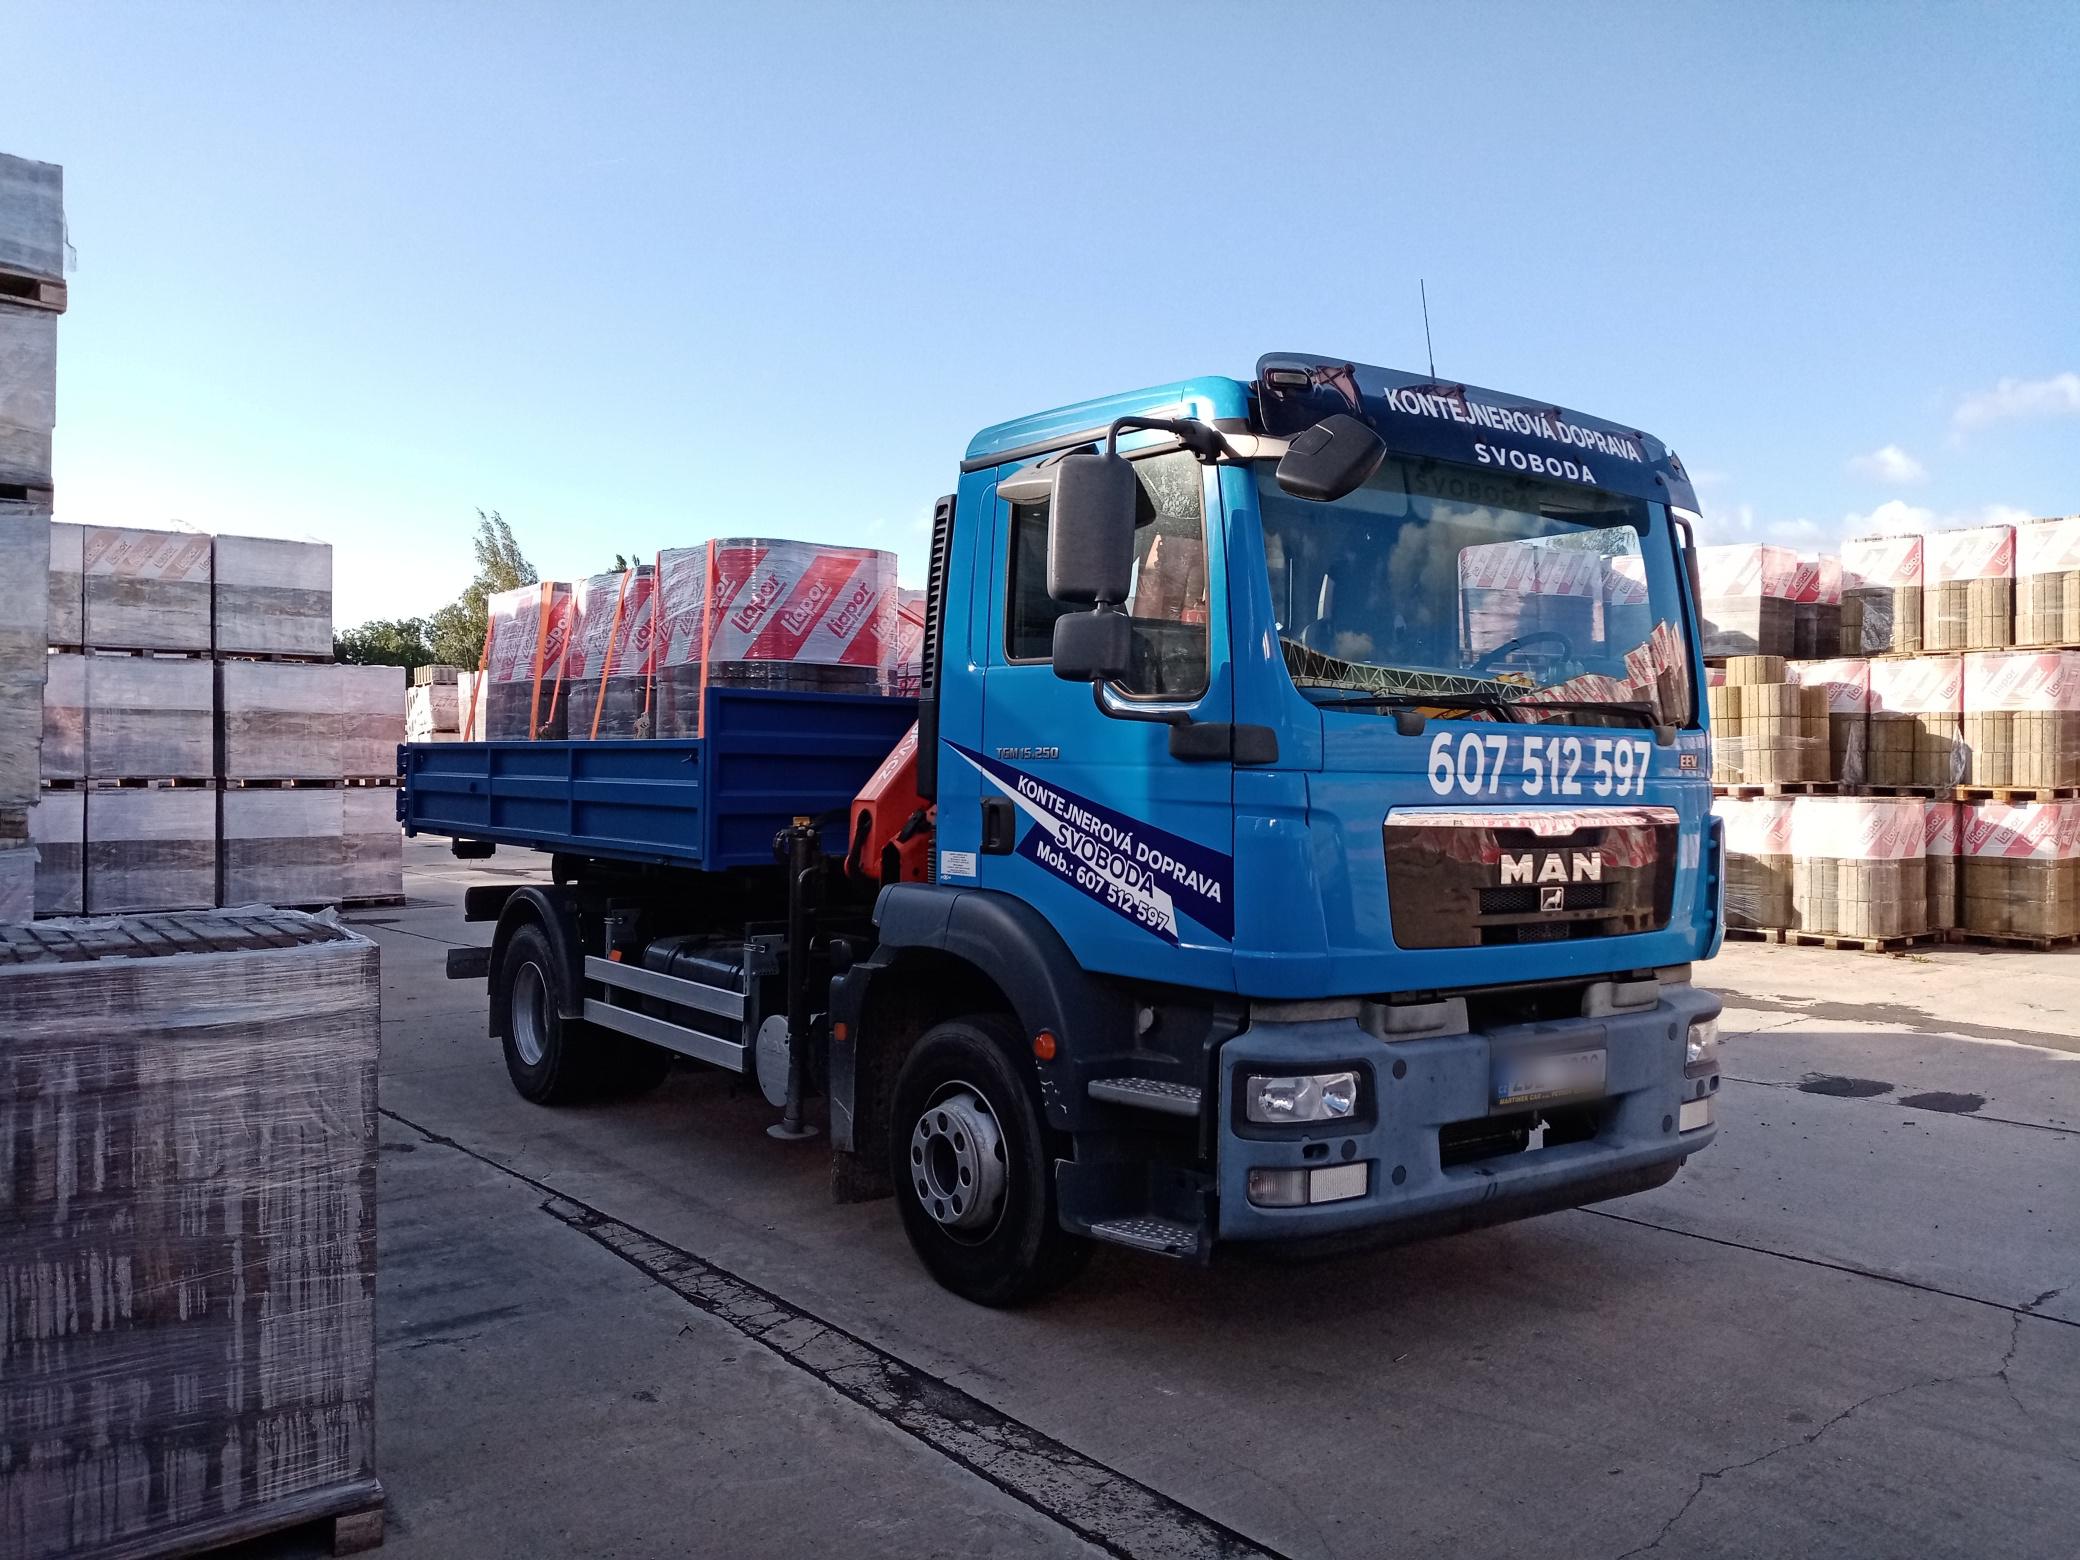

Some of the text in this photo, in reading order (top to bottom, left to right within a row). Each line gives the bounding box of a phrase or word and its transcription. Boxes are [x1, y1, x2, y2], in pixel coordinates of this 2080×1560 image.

[1385, 388, 1641, 463] KONTEJNEROVÁ DOPRAVA
[1474, 442, 1597, 485] SVOBODA
[731, 571, 787, 634] Liapor
[780, 577, 832, 637] Liapor
[826, 581, 876, 639] Liapor
[1428, 731, 1651, 797] 607 512 597
[1017, 775, 1222, 904] KONTEJNEROVÁ DOPRAVA
[1055, 822, 1154, 900] SVOBODA
[1500, 851, 1602, 885] MAN
[1036, 840, 1170, 931] Mob.: 607 512 597
